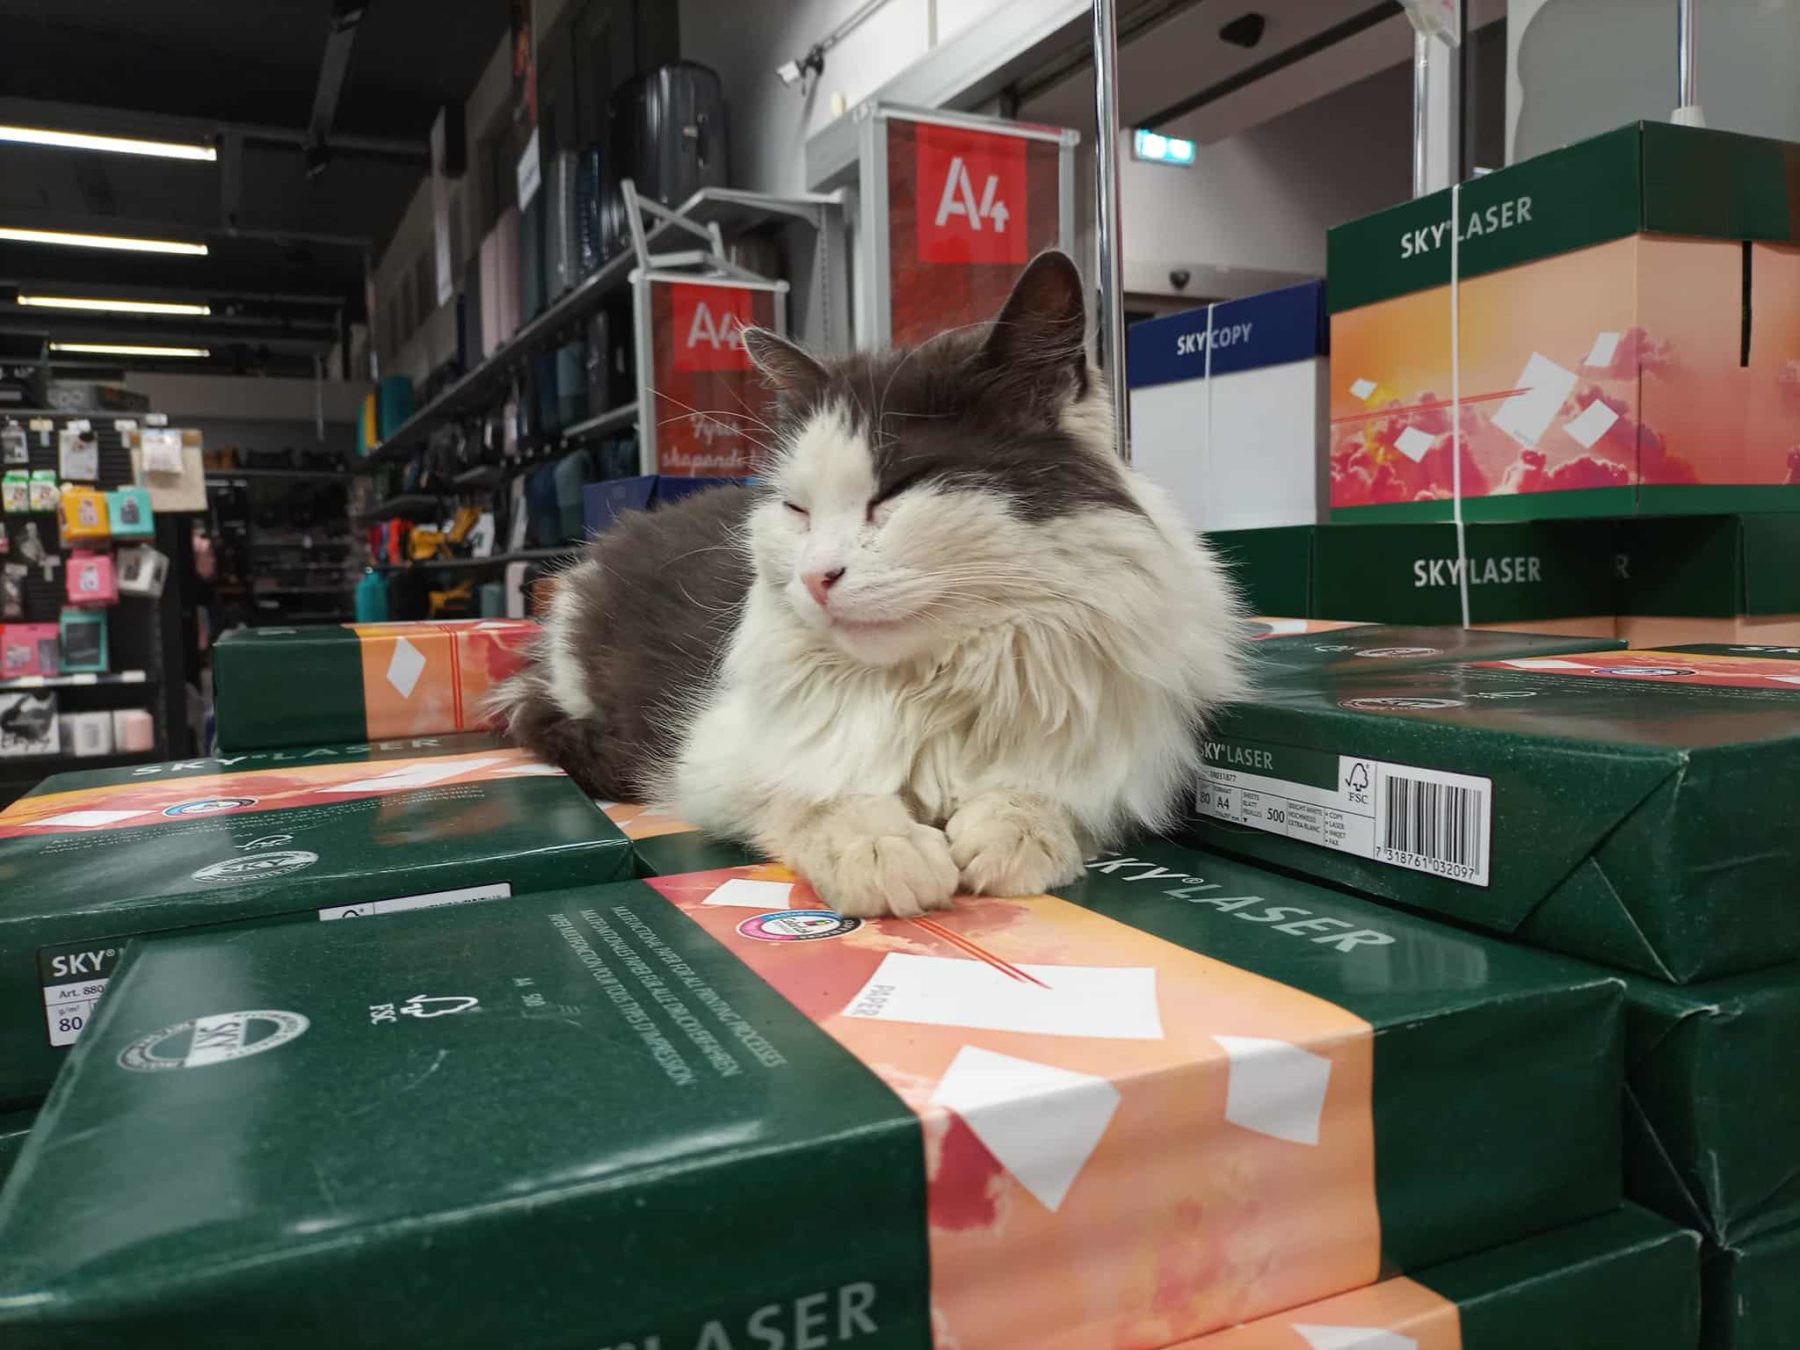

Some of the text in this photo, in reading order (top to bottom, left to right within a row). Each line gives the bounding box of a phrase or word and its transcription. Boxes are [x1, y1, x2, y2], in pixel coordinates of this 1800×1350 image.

[934, 156, 1010, 233] A4
[687, 302, 744, 350] A4
[1217, 796, 1229, 810] A4
[1348, 791, 1369, 805] FSC
[1266, 807, 1285, 823] 500
[1375, 846, 1475, 880] 7 318761 032097
[58, 989, 80, 999] Art.
[59, 1016, 83, 1032] 80
